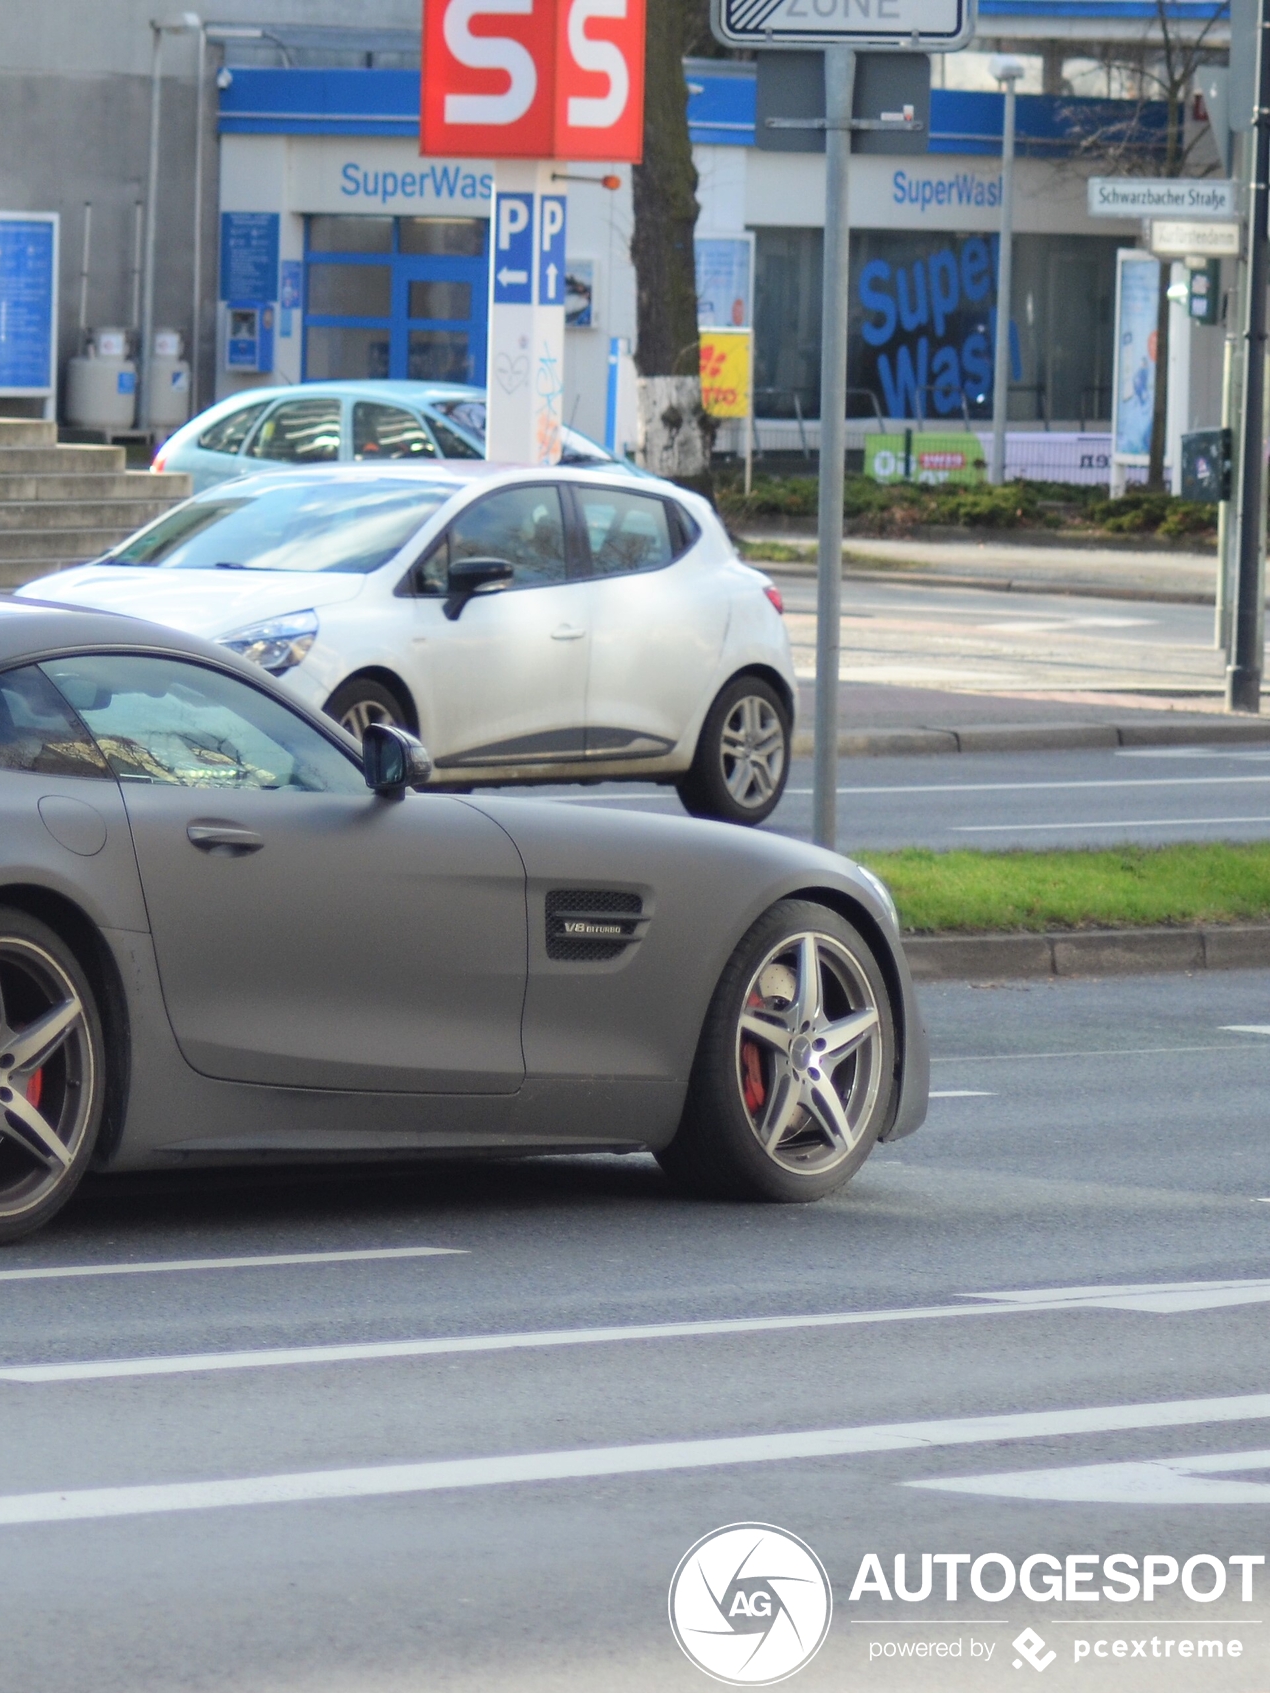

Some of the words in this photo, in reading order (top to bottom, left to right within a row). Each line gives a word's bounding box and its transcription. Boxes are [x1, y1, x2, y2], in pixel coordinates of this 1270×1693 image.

[341, 162, 494, 204] SuperWas
[1099, 186, 1185, 206] Schwarzbacher
[1188, 188, 1226, 210] Straße
[499, 200, 529, 250] P
[543, 200, 564, 251] P
[564, 922, 585, 932] V8
[586, 925, 621, 934] BITURBO
